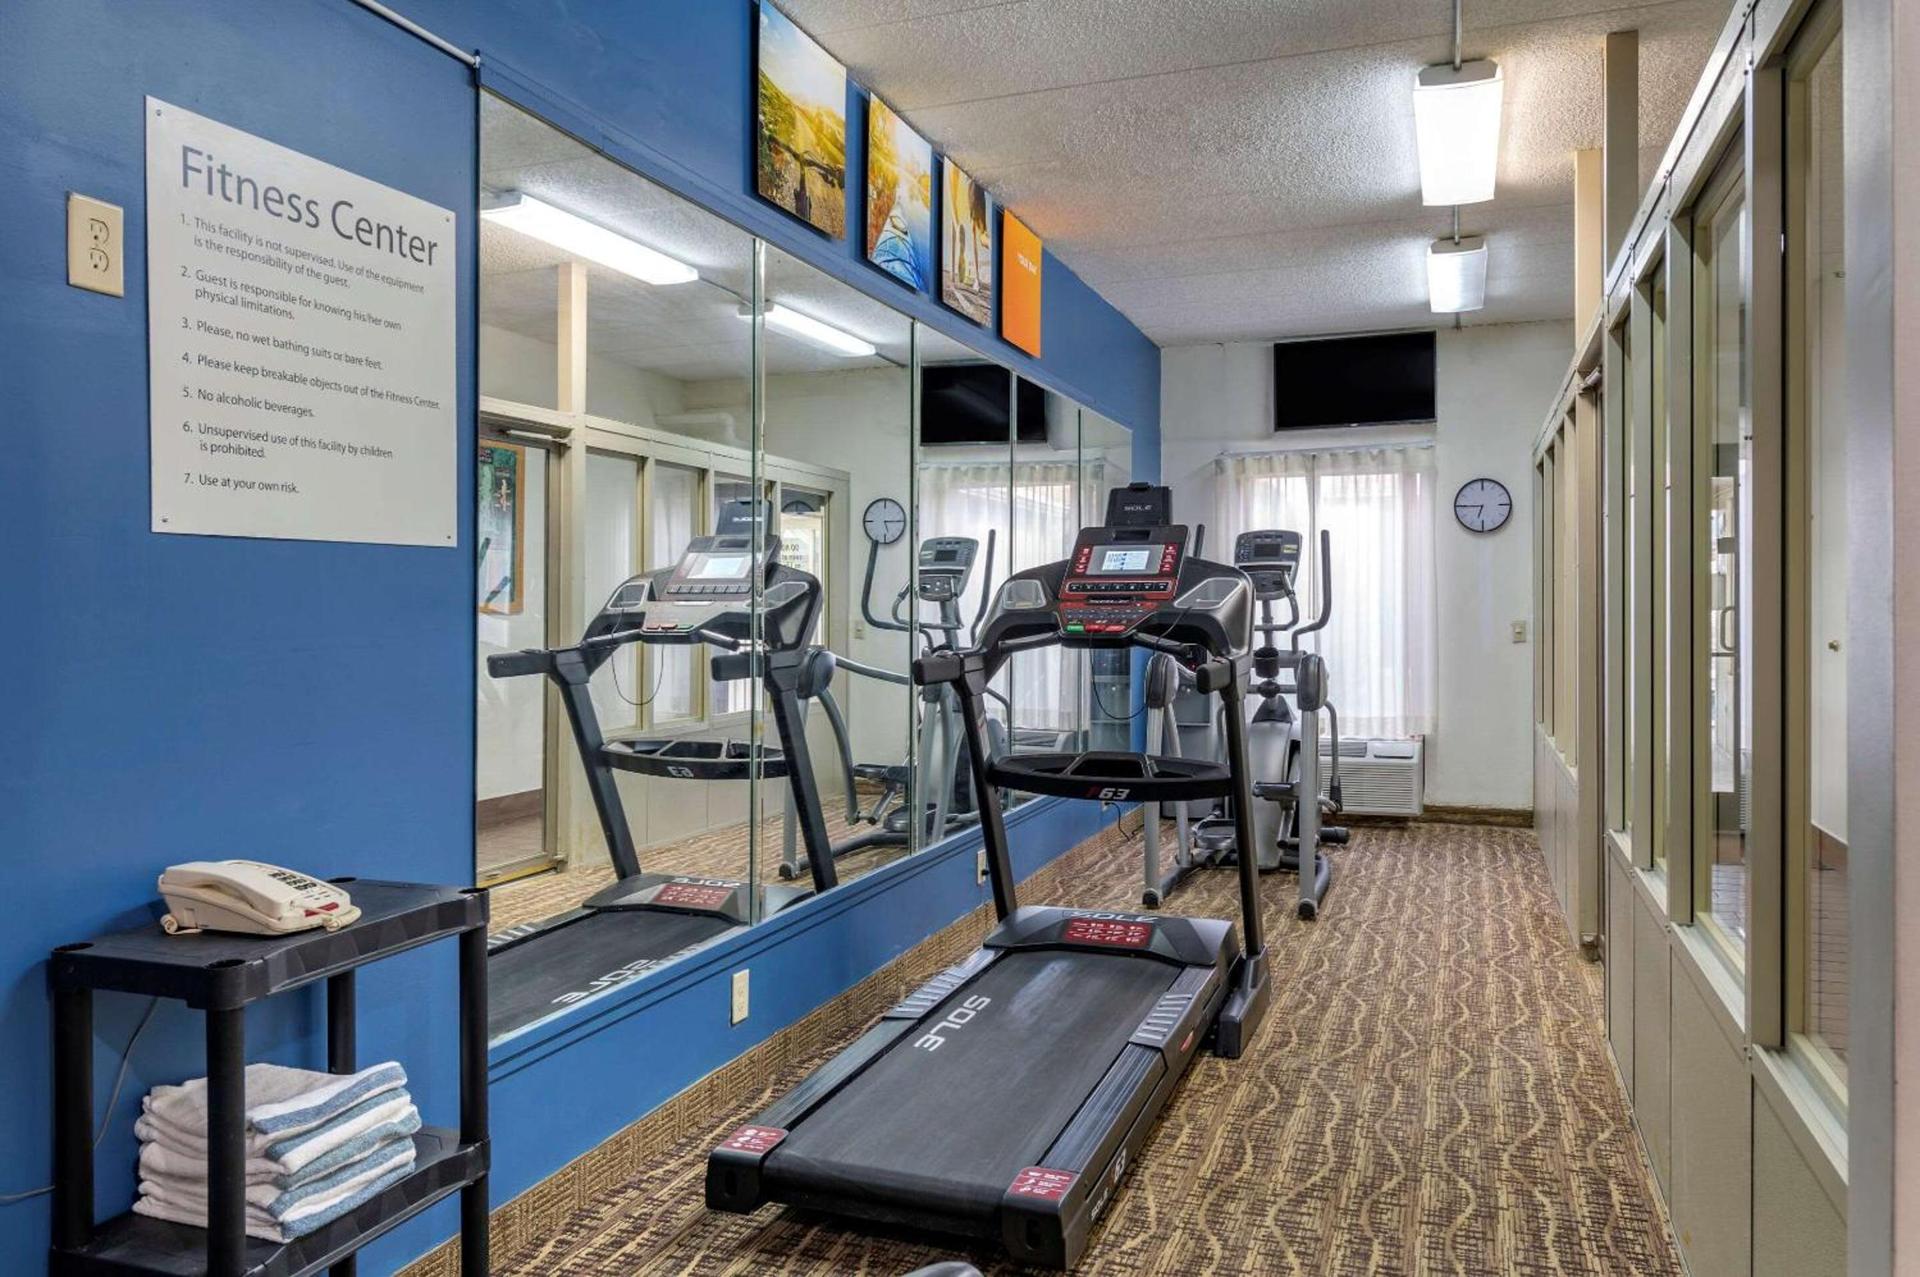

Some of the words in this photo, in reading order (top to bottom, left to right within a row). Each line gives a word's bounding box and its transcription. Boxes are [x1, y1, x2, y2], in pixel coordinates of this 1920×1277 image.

[182, 145, 320, 228] Fitness
[331, 201, 437, 266] Center
[181, 213, 191, 225] 1.
[194, 217, 216, 233] This
[219, 223, 253, 246] facility
[255, 235, 264, 247] is
[265, 240, 282, 253] not
[284, 246, 336, 269] supervised.
[338, 260, 354, 273] Use
[355, 266, 364, 276] of
[366, 268, 380, 281] the
[381, 275, 425, 294] equipment
[194, 235, 203, 247] is
[205, 239, 223, 252] the
[225, 245, 292, 274] responsibility
[295, 264, 304, 274] of
[306, 266, 321, 280] the
[323, 274, 351, 289] guest.
[181, 265, 192, 278] 2.
[195, 269, 227, 287] Guest
[230, 278, 238, 289] is
[240, 282, 297, 304] responsible
[299, 295, 311, 308] for
[314, 298, 351, 321] knowing
[383, 319, 402, 331] own
[195, 288, 239, 305] physical
[241, 296, 295, 320] limitations.
[182, 316, 192, 330] 3.
[197, 320, 233, 339] Please,
[236, 331, 250, 342] no
[252, 334, 271, 346] wet
[273, 336, 309, 356] bathing
[312, 346, 331, 359] suits
[333, 352, 343, 361] or
[345, 352, 363, 366] bare
[365, 357, 383, 370] feet.
[182, 351, 192, 365] 4.
[197, 354, 231, 371] Please
[234, 360, 260, 378] keep
[262, 366, 308, 385] breakable
[309, 376, 342, 391] objects
[343, 384, 359, 395] out
[360, 386, 369, 396] of
[370, 388, 384, 399] the
[385, 391, 413, 405] Fitness
[414, 396, 440, 409] Center.
[183, 386, 193, 399] 5.
[198, 388, 214, 402] No
[216, 392, 263, 409] alcoholic
[264, 399, 315, 418] beverages.
[183, 420, 193, 433] 6.
[198, 423, 269, 442] Unsupervised
[270, 434, 288, 445] use
[289, 436, 299, 446] of
[300, 436, 317, 449] this
[318, 439, 346, 455] facility
[348, 443, 359, 456] by
[360, 445, 393, 459] children
[200, 440, 208, 452] is
[210, 442, 266, 458] prohibited.
[184, 472, 195, 485] 7.
[199, 474, 218, 486] Use
[221, 478, 232, 488] at
[233, 479, 257, 491] your
[258, 481, 279, 491] own
[280, 482, 300, 494] risk.
[913, 994, 991, 1052] SOLE
